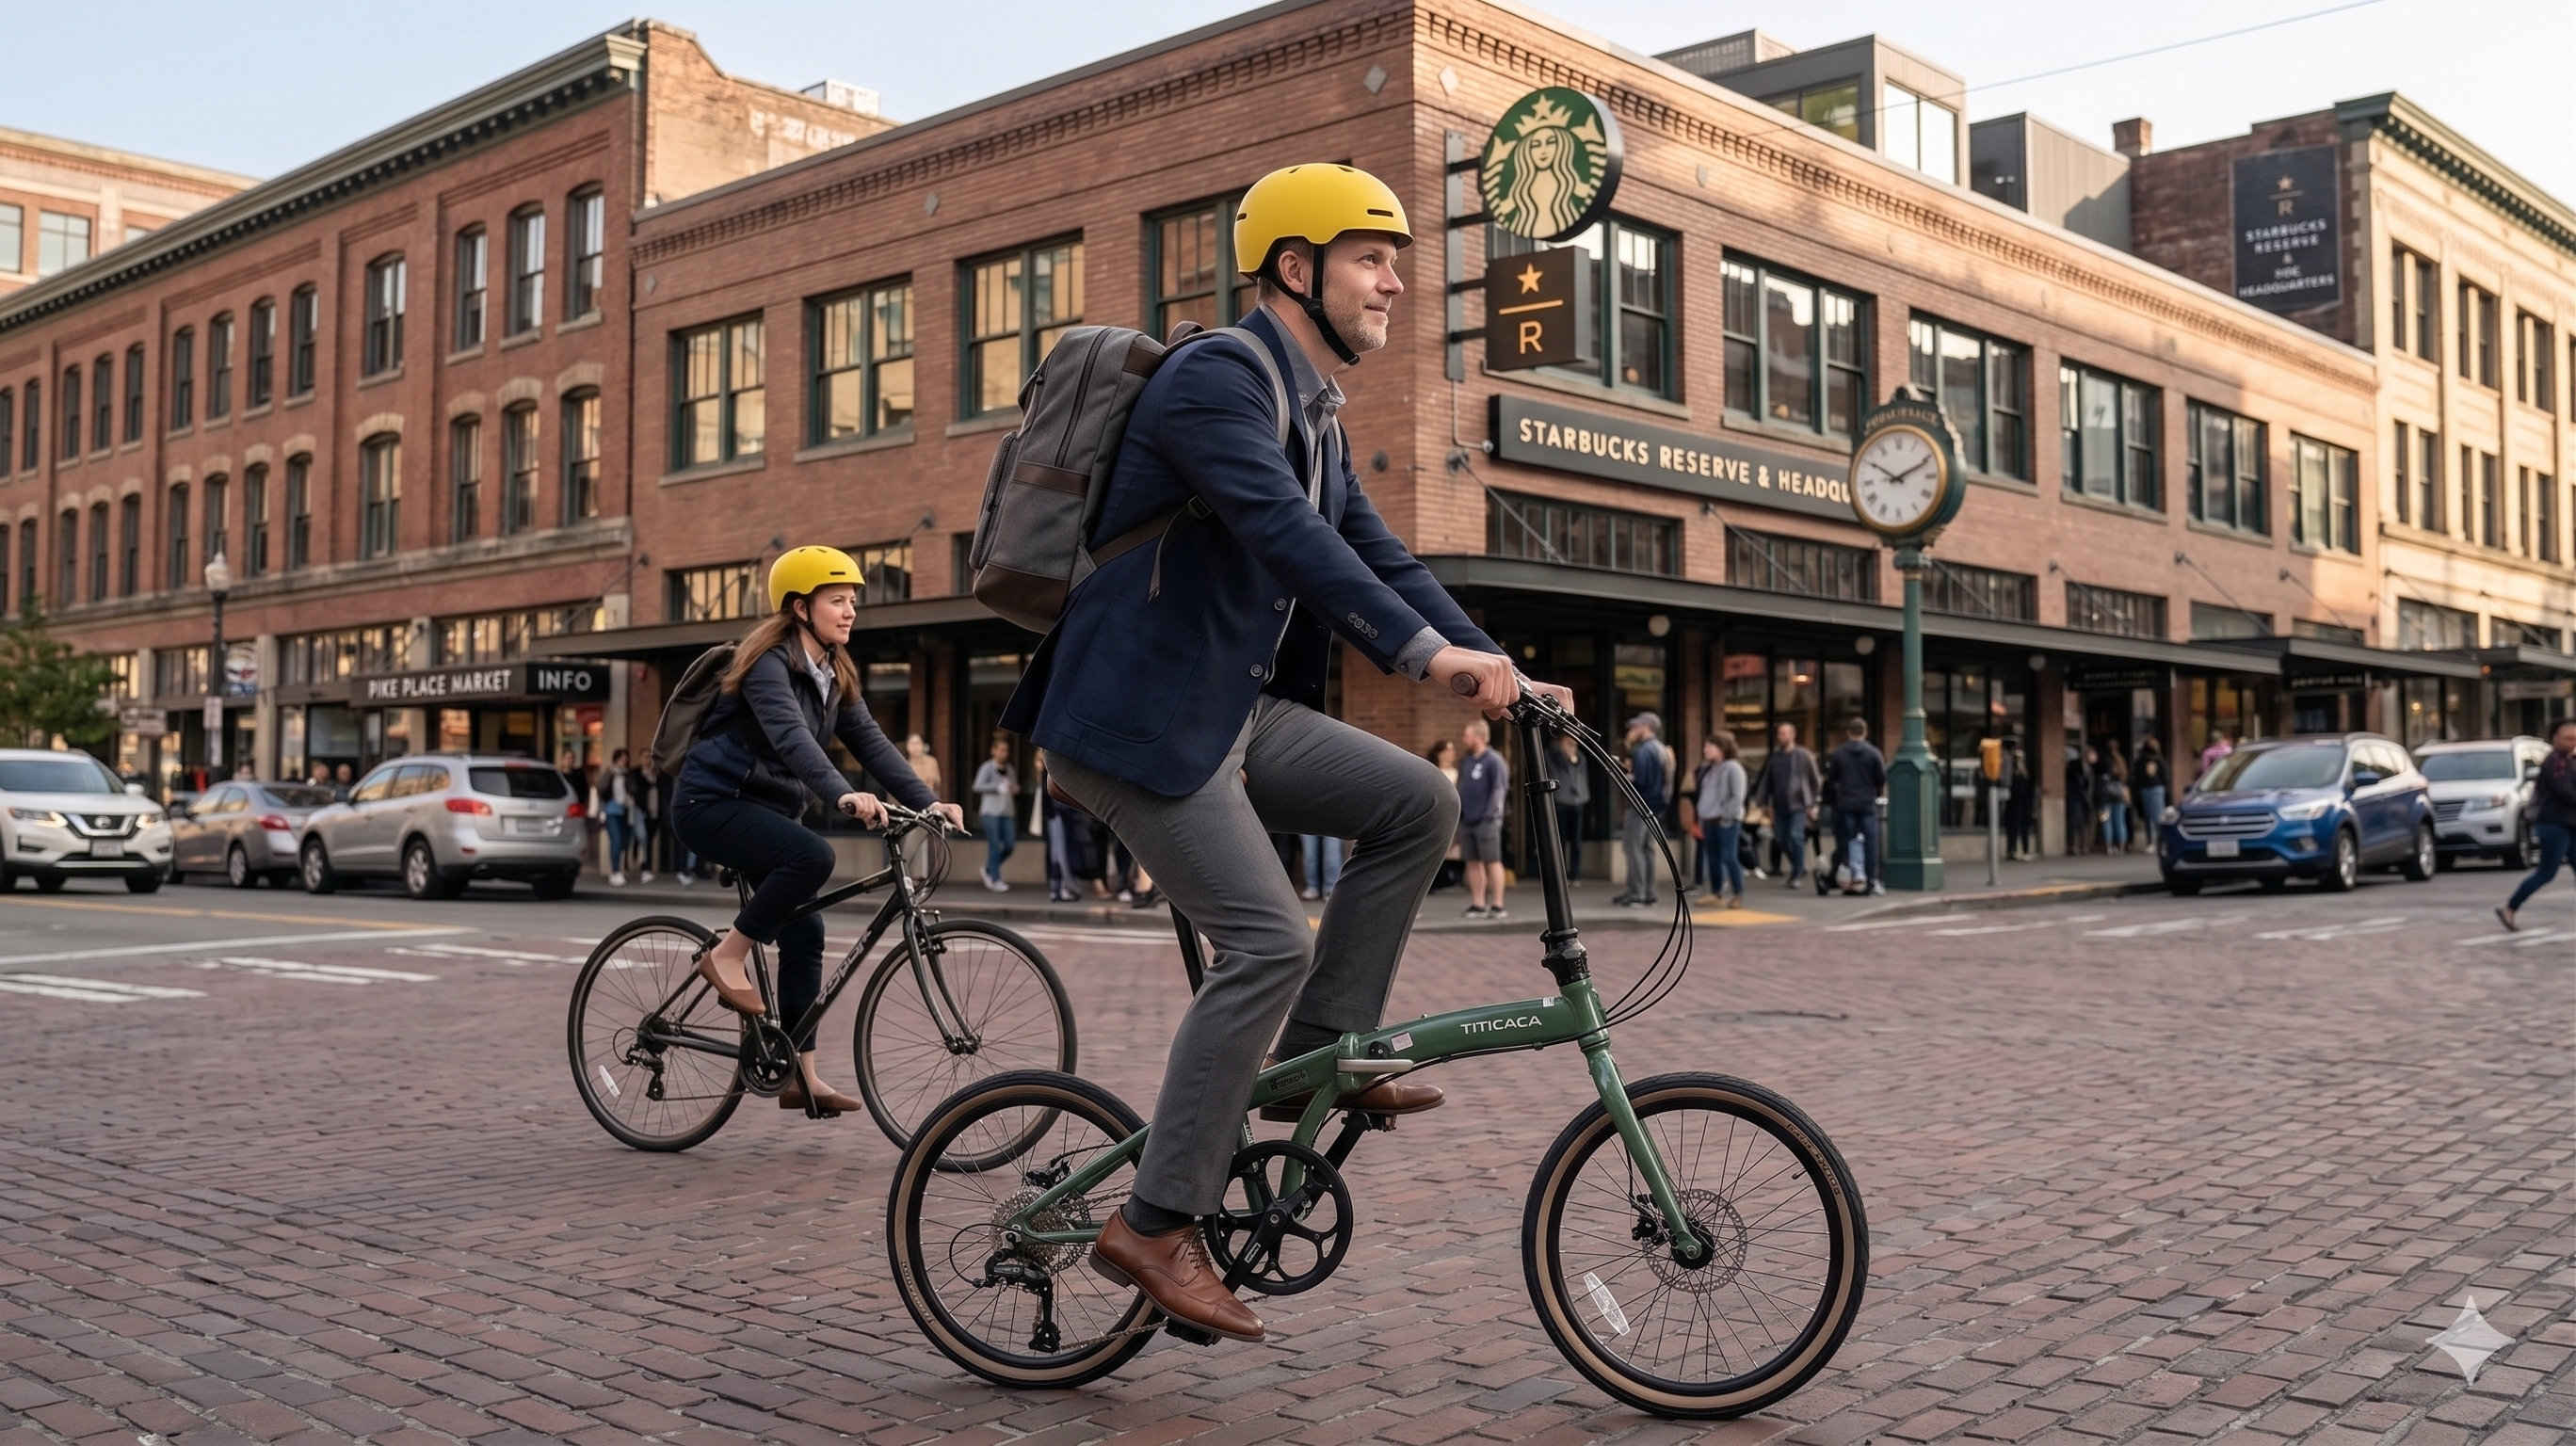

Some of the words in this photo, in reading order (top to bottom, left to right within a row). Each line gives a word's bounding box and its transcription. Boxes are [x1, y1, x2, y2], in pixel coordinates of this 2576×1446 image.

[2278, 199, 2294, 217] R
[2245, 217, 2326, 243] STARBUCKS
[2254, 233, 2319, 254] RESERVE
[2239, 273, 2335, 297] HEADQUARTERS
[1520, 320, 1542, 354] R
[1519, 417, 1649, 465] STARBUCKS
[1659, 444, 1750, 485] RESERVE
[1757, 464, 1770, 490] &
[368, 679, 398, 699] PIKE
[402, 674, 446, 698] PLACE
[451, 669, 512, 694] MARKET
[538, 669, 592, 691] INFO
[1460, 1015, 1542, 1035] TITICACA
